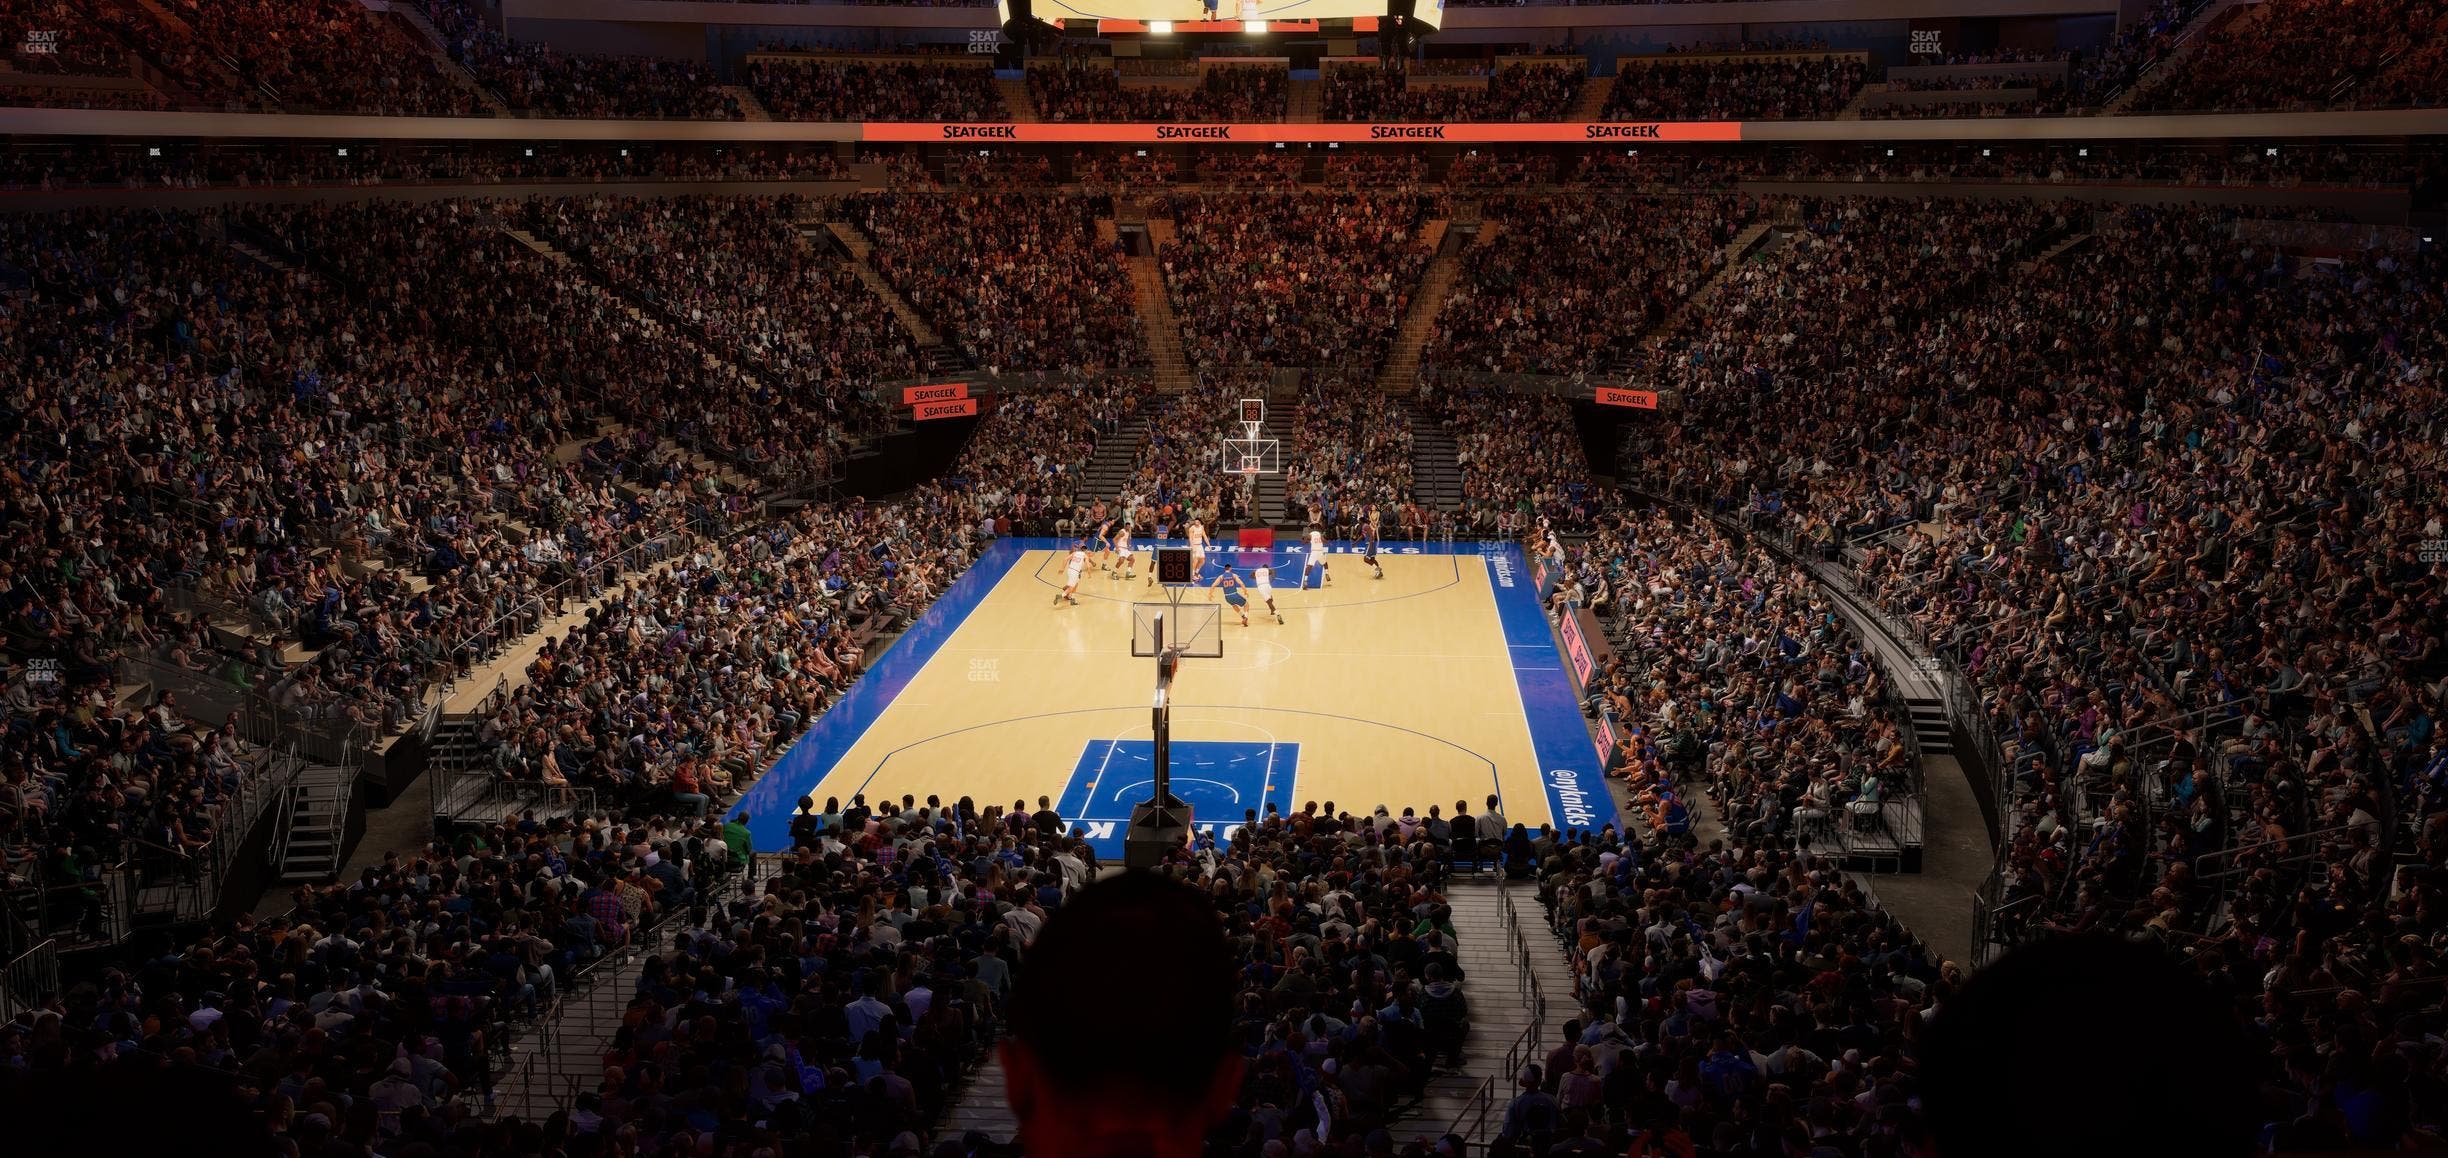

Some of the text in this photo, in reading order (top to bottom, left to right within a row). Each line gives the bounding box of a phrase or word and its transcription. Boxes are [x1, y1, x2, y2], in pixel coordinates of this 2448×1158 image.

[943, 126, 1016, 138] SEATGEEK
[1157, 126, 1231, 138] SEATGEEK
[1371, 126, 1444, 139] SEATGEEK
[1586, 125, 1660, 138] SEATGEEK
[914, 388, 956, 400] SEATGEEK
[1607, 392, 1648, 406] SEATGEEK
[924, 404, 966, 417] SEATGEEK
[1286, 546, 1421, 554] KICKS
[1549, 770, 1596, 826] @nyknicks
